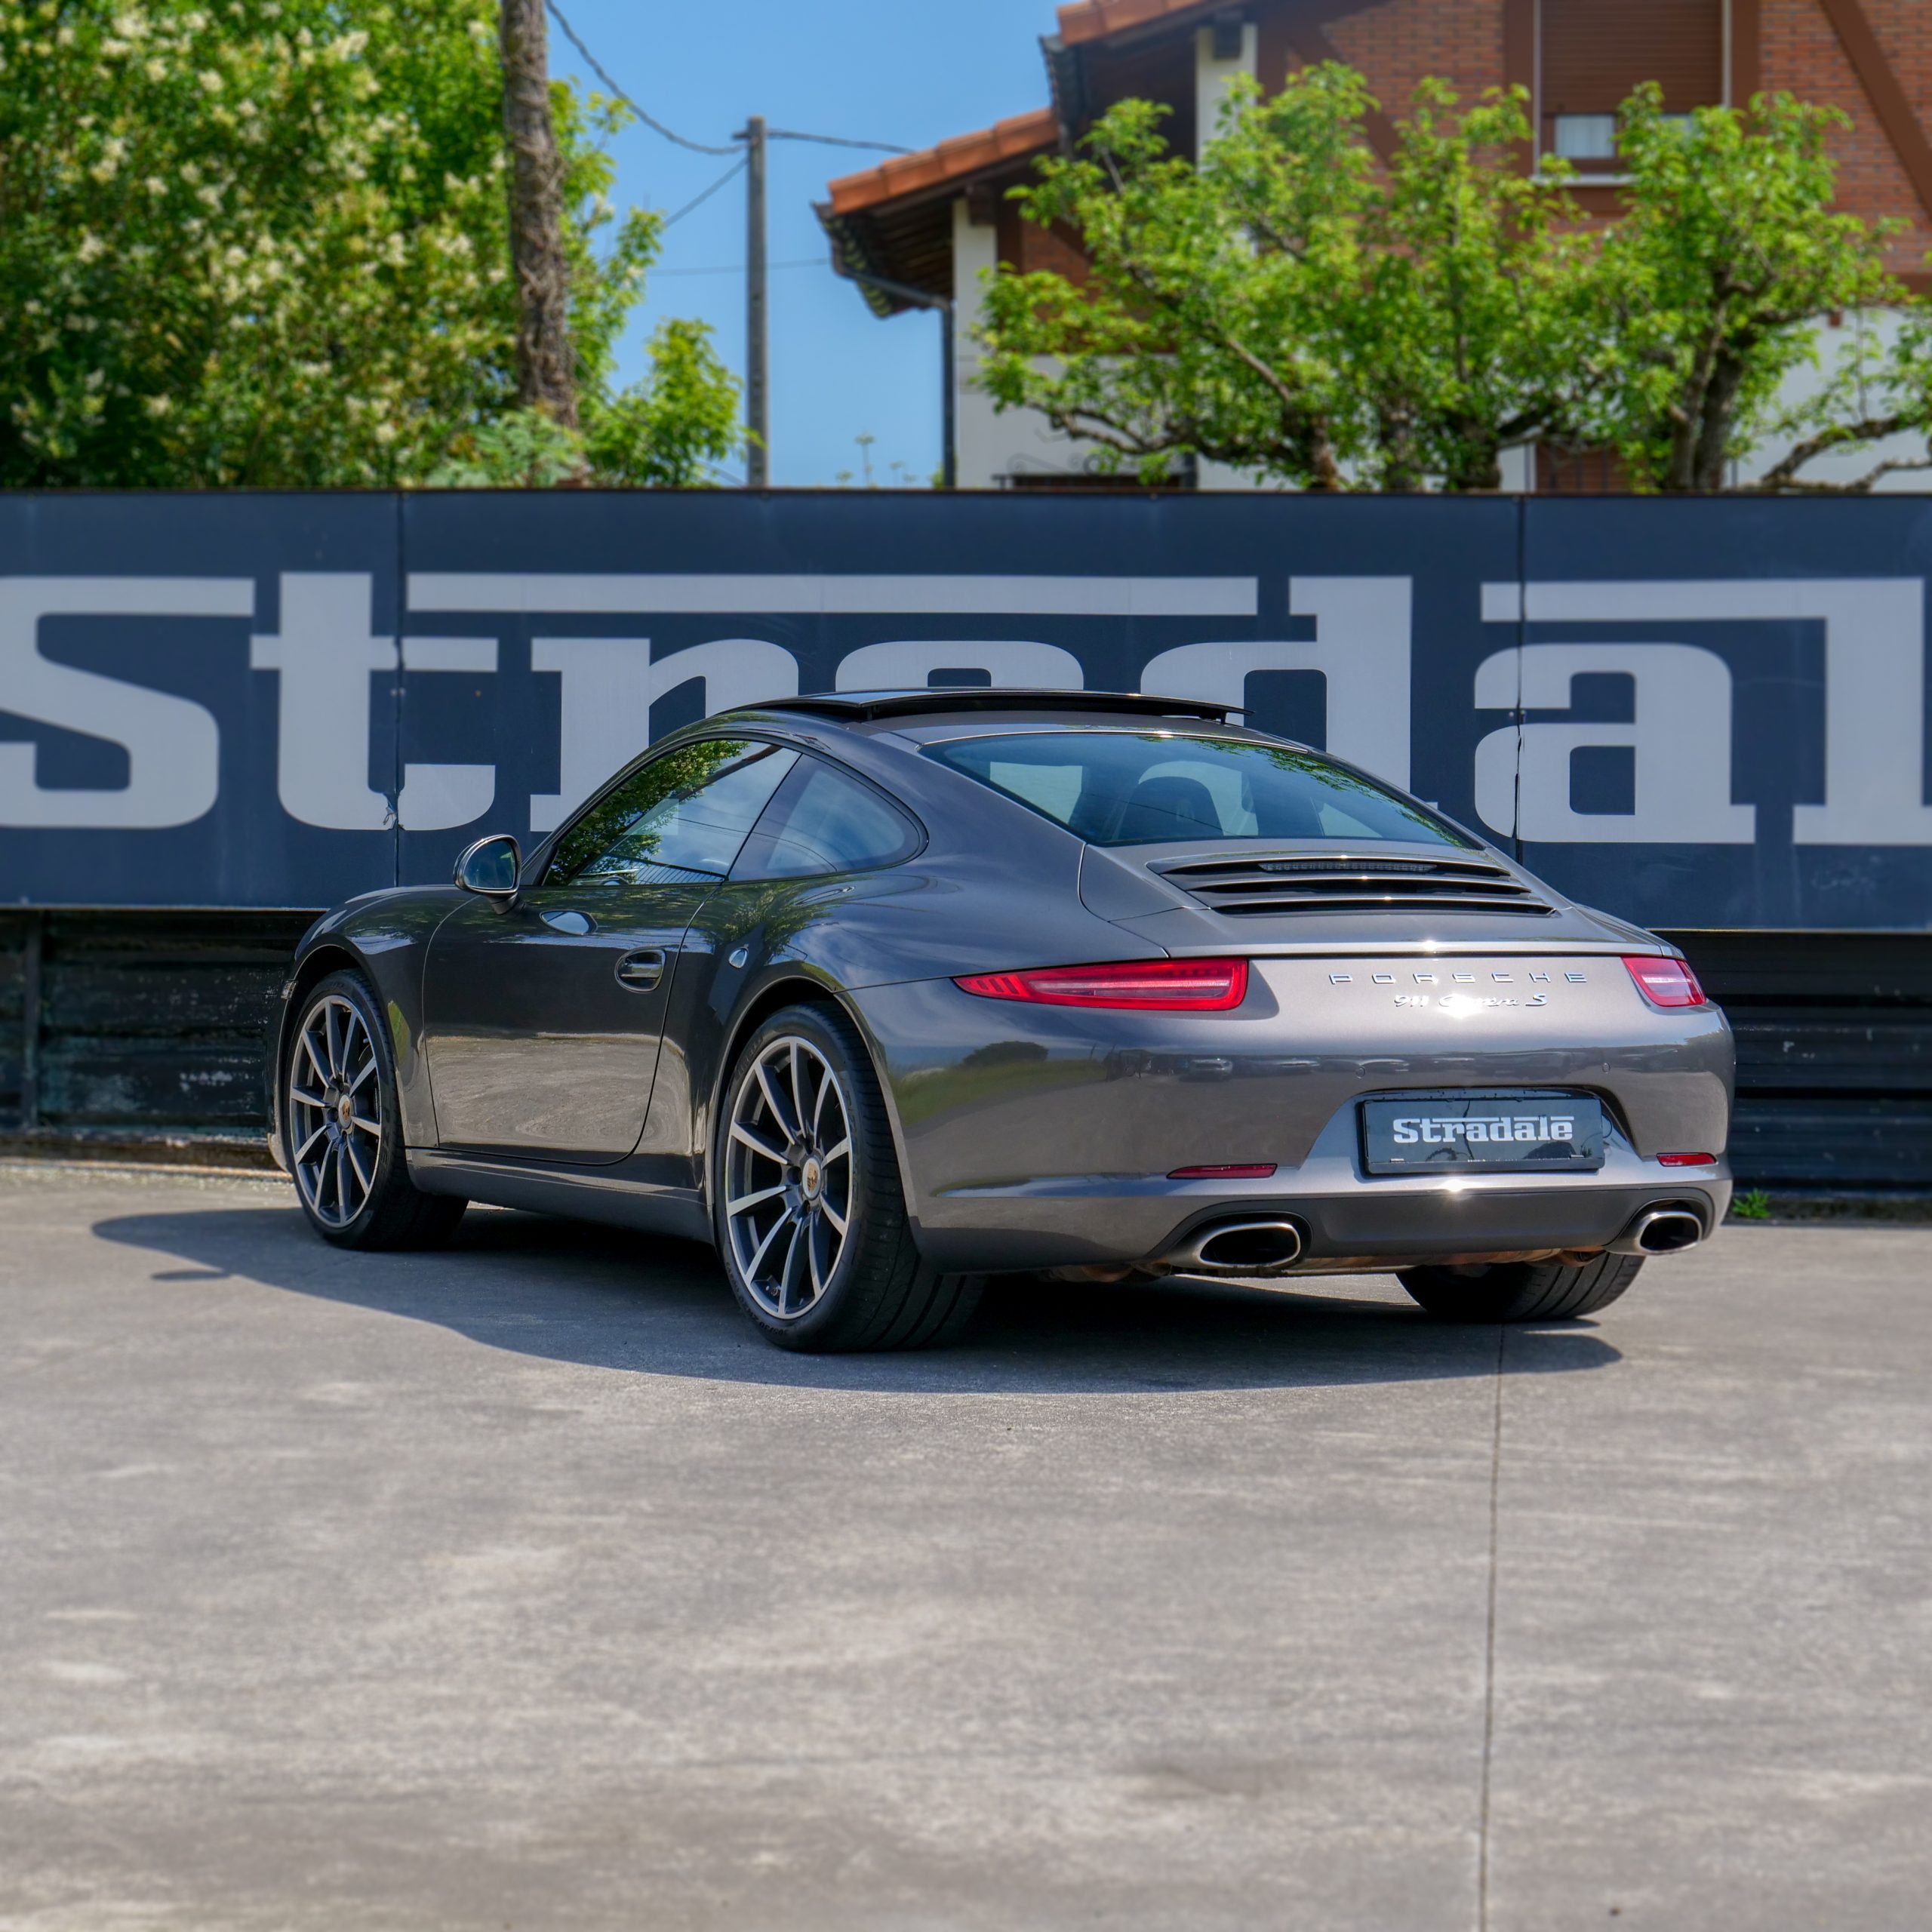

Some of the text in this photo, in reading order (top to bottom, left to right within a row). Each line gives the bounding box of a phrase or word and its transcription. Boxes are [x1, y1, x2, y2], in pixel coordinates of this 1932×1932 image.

[1329, 972, 1587, 985] PORSCHE
[1394, 994, 1430, 1008] 911
[1524, 992, 1548, 1007] S
[1392, 1115, 1575, 1144] Stradale
